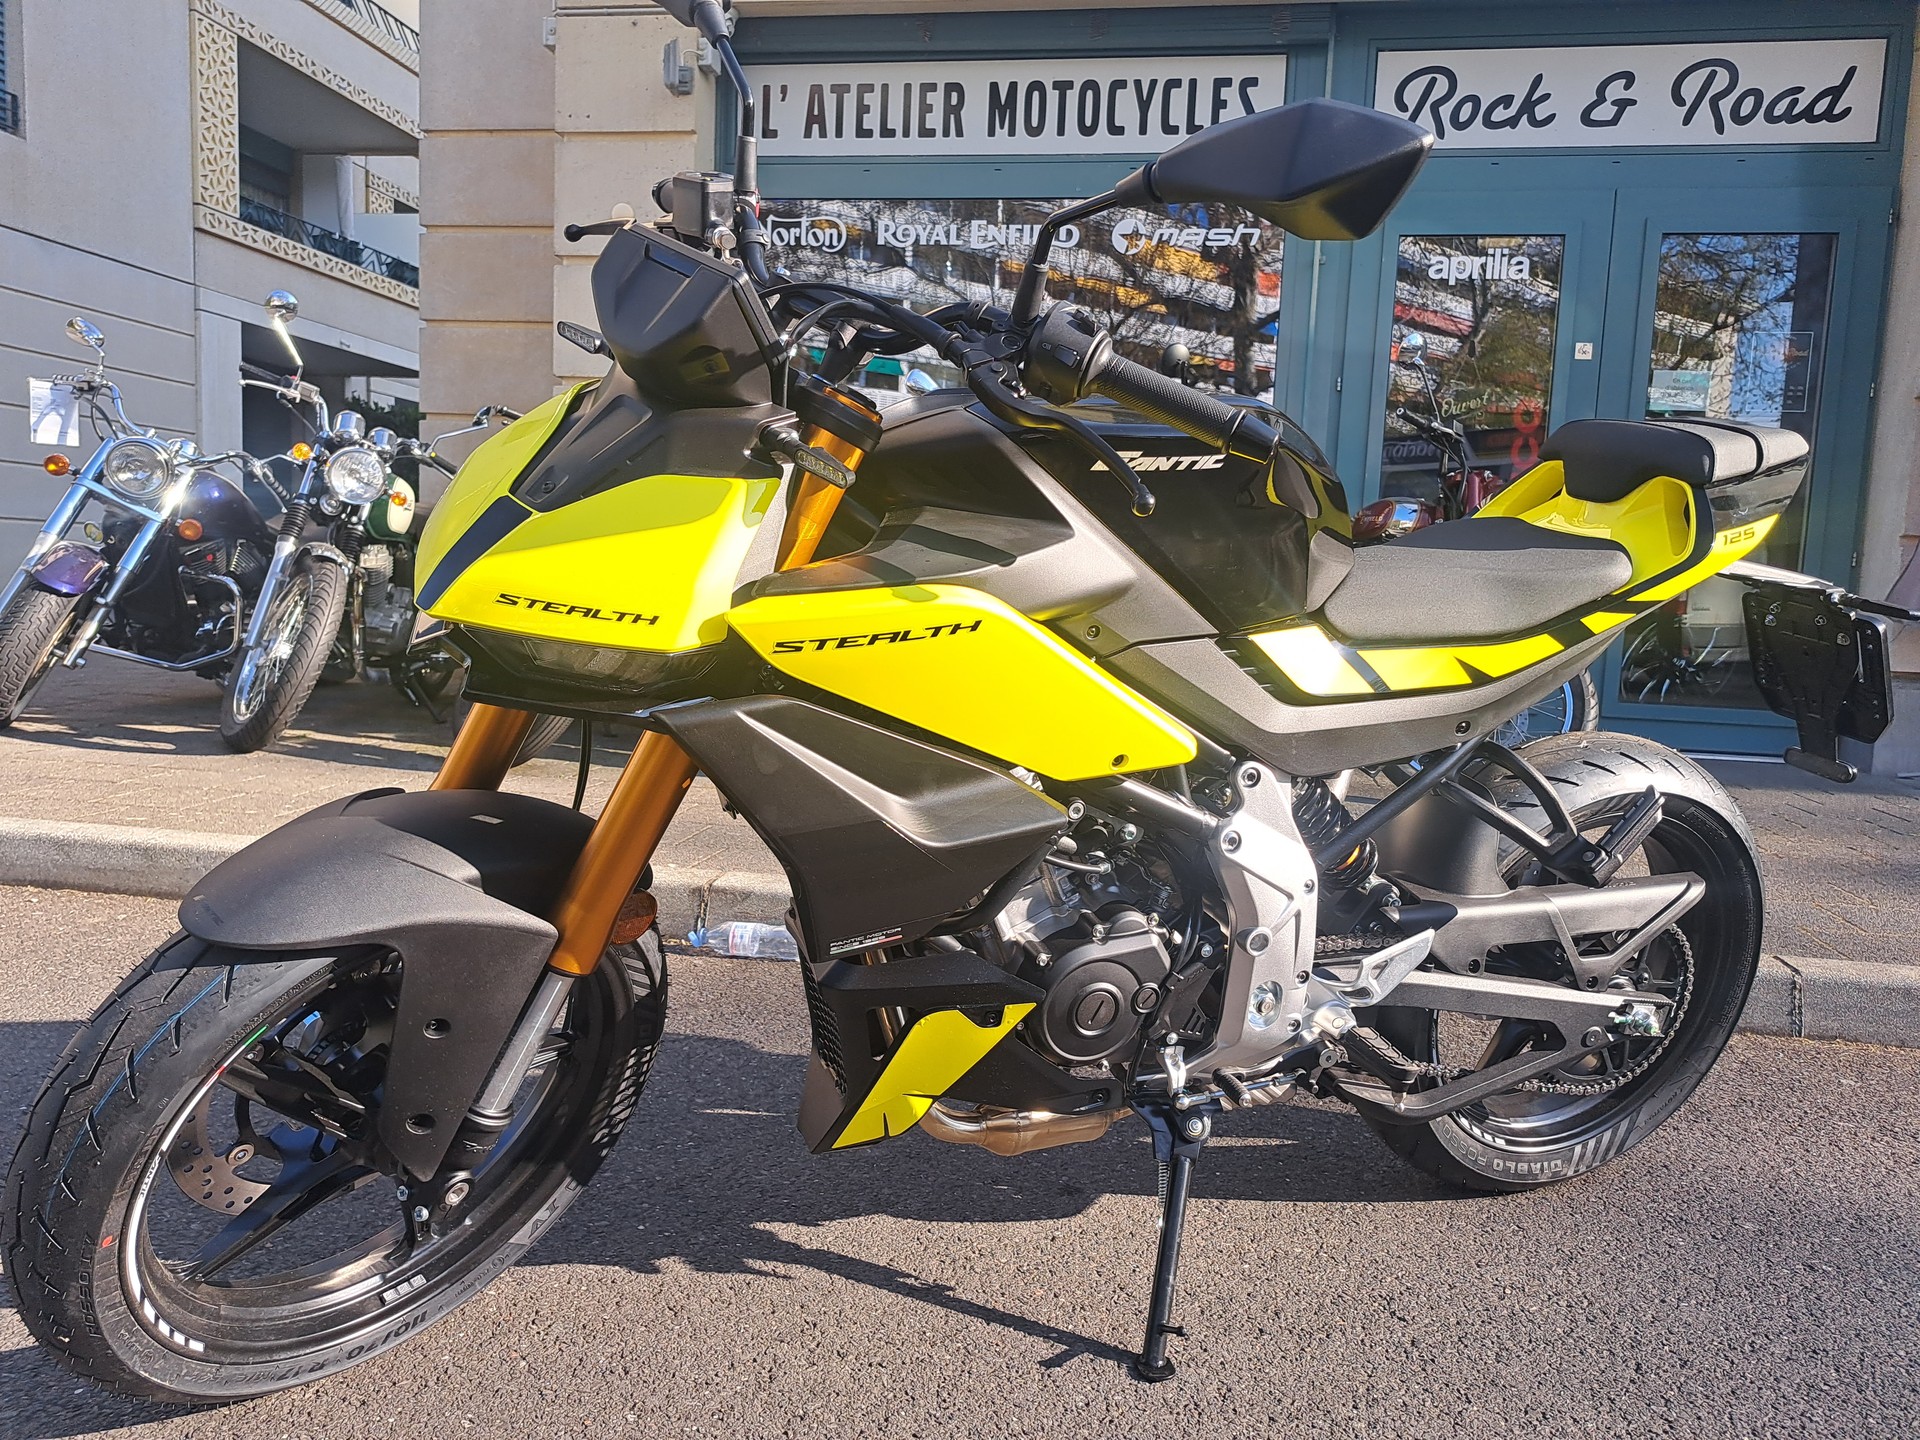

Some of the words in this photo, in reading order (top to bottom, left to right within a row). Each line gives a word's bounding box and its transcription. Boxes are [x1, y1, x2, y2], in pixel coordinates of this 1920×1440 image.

[803, 82, 966, 140] ATELIER
[1393, 65, 1557, 140] Rock
[1579, 70, 1638, 128] &
[1670, 58, 1858, 135] Road
[876, 219, 963, 248] ROYAL
[1427, 247, 1531, 282] aprilia
[1441, 391, 1489, 418] Ouvert
[1722, 526, 1756, 546] 125
[494, 592, 660, 626] STEALTH
[771, 619, 983, 655] STEALTH
[1441, 1123, 1489, 1167] ROSSO
[1491, 1158, 1563, 1175] DIABLO
